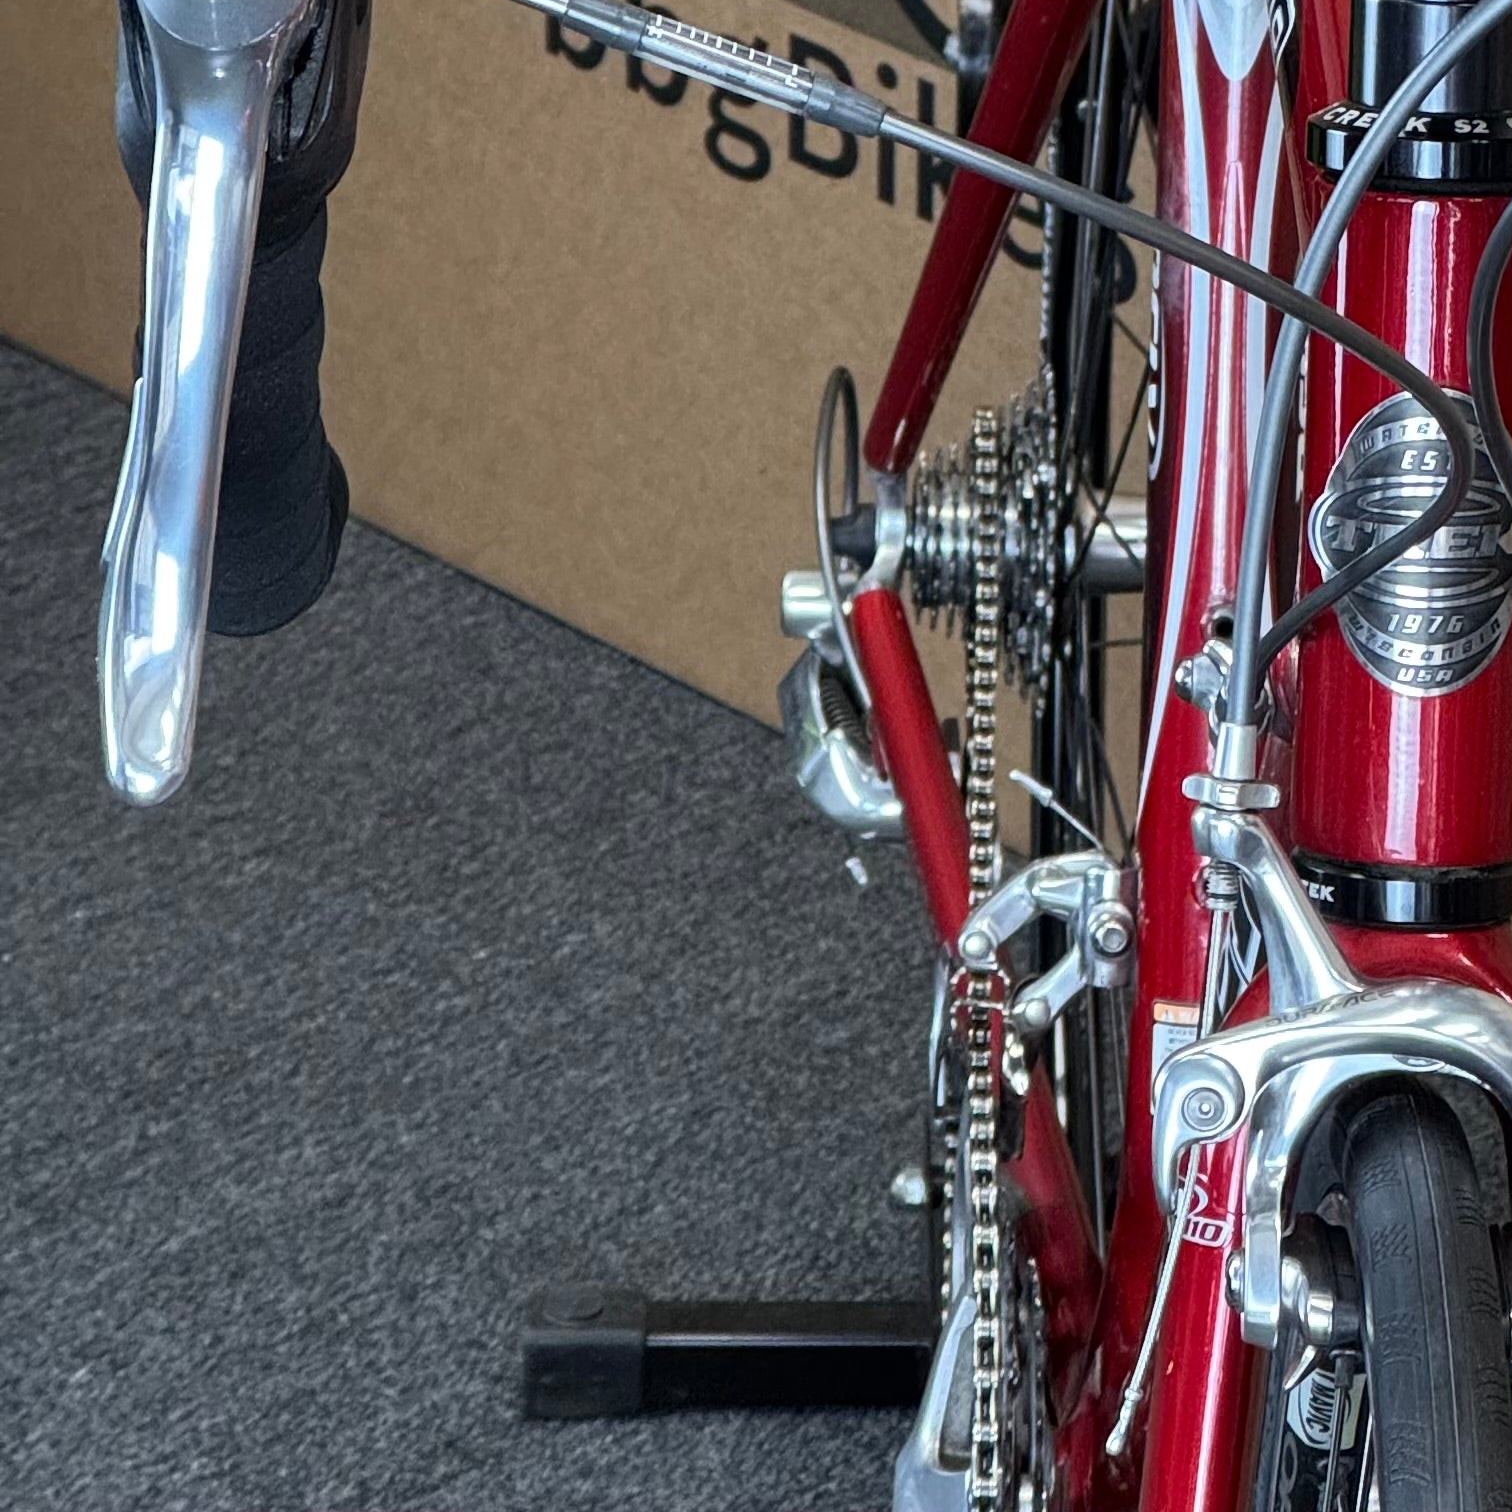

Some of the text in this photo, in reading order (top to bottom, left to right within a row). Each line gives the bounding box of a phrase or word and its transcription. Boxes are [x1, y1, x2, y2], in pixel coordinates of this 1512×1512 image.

[1323, 106, 1432, 136] CREK
[1454, 120, 1490, 135] S2
[1400, 449, 1452, 472] ES
[1387, 614, 1465, 635] 1976
[1347, 617, 1501, 662] WISCONSIN
[1397, 668, 1454, 683] USA
